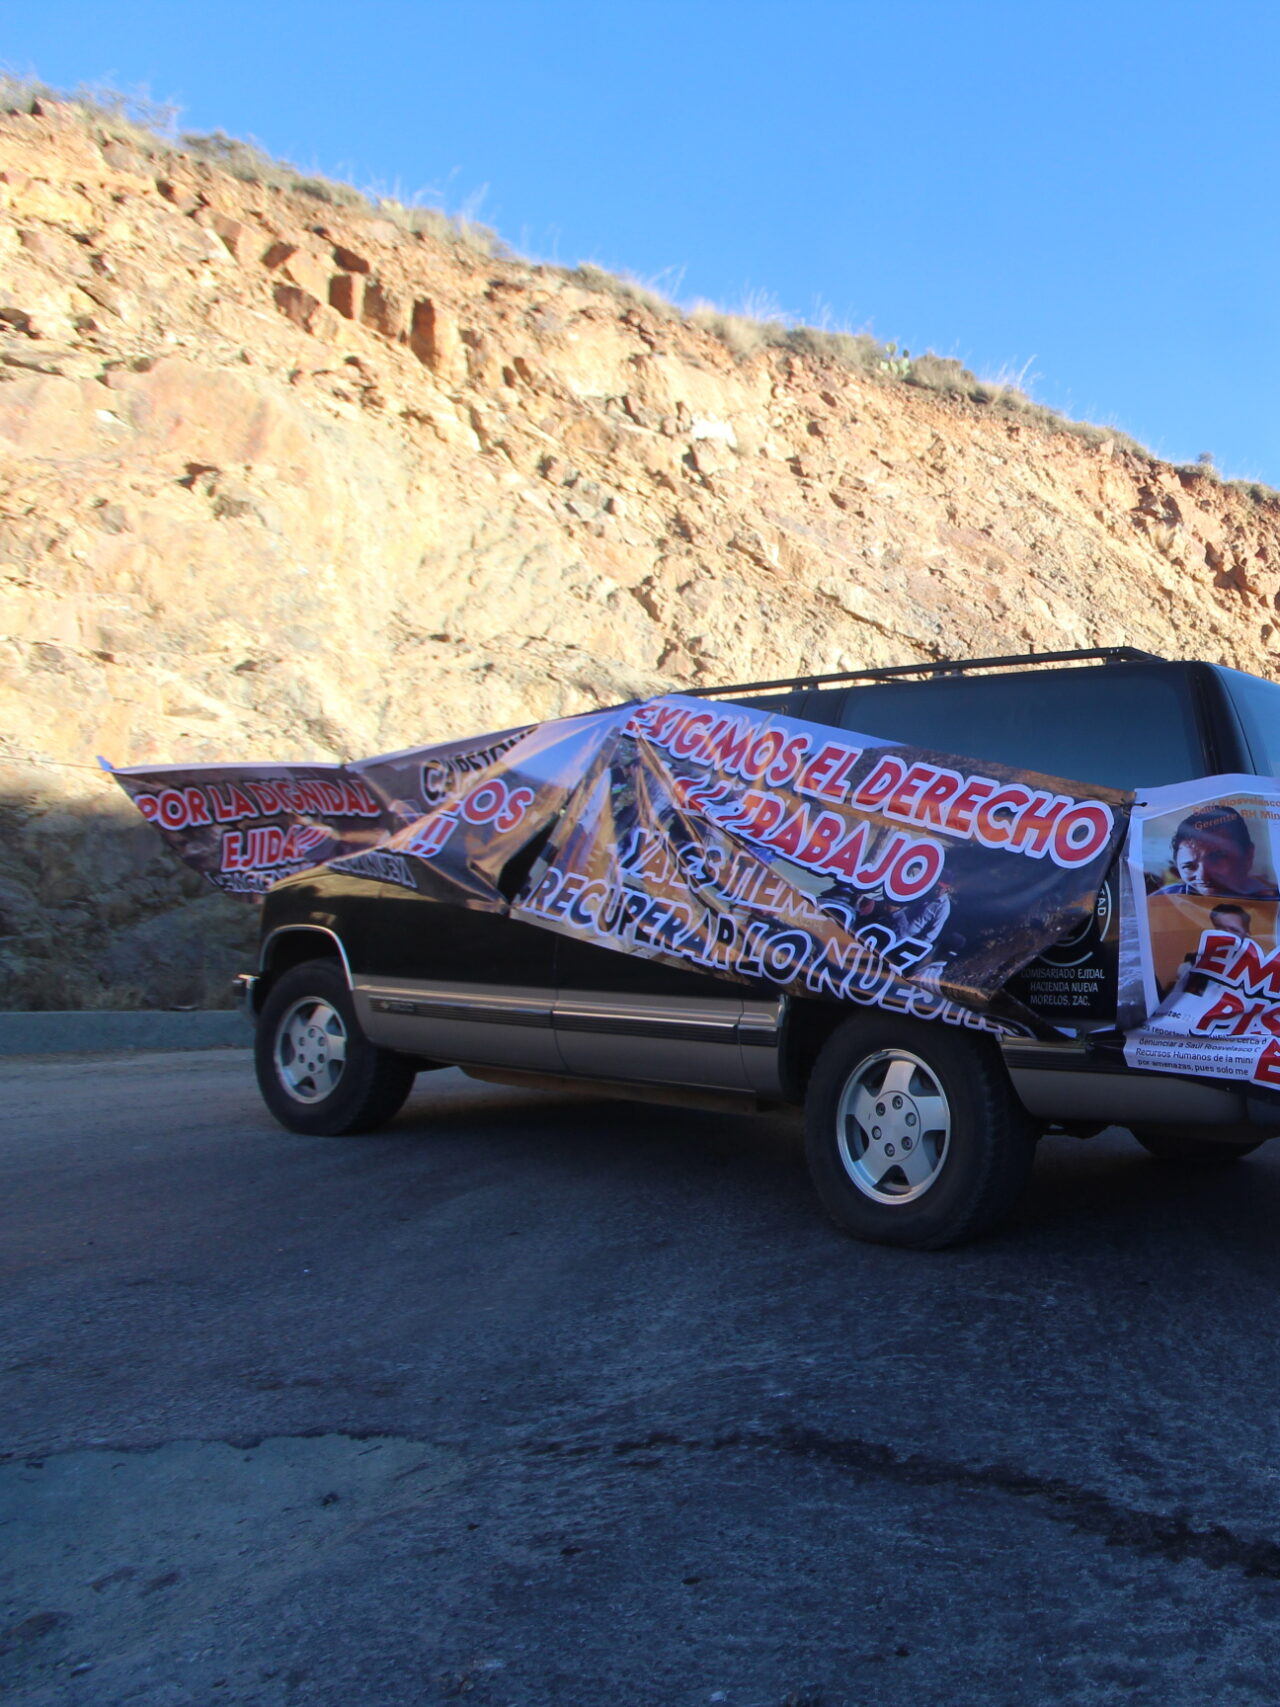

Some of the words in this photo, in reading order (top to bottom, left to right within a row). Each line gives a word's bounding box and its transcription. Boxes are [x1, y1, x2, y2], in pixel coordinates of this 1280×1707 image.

[620, 704, 809, 788] EXIGIMOS
[802, 746, 862, 802] EL
[853, 757, 1114, 868] DERECHO
[134, 788, 213, 830] POR
[209, 783, 260, 822] LA
[716, 792, 944, 900] TRABAJO
[523, 867, 738, 970] RECUPERAR
[736, 921, 813, 984] LO
[806, 937, 1037, 1040] NUES
[1020, 968, 1075, 979] COMISARIADO
[1077, 968, 1106, 980] EJIDAL
[1030, 981, 1070, 992] HACIENDA
[1071, 981, 1099, 992] NUEVA
[1138, 1037, 1179, 1048] denunciar
[1185, 1041, 1202, 1050] Saúl
[1136, 1048, 1171, 1058] Recursos
[1173, 1051, 1211, 1061] Humanos
[1213, 1054, 1223, 1063] de
[1138, 1059, 1150, 1067] por
[1152, 1060, 1194, 1071] amenazas,
[1194, 1064, 1214, 1074] pues
[1216, 1065, 1234, 1074] solo
